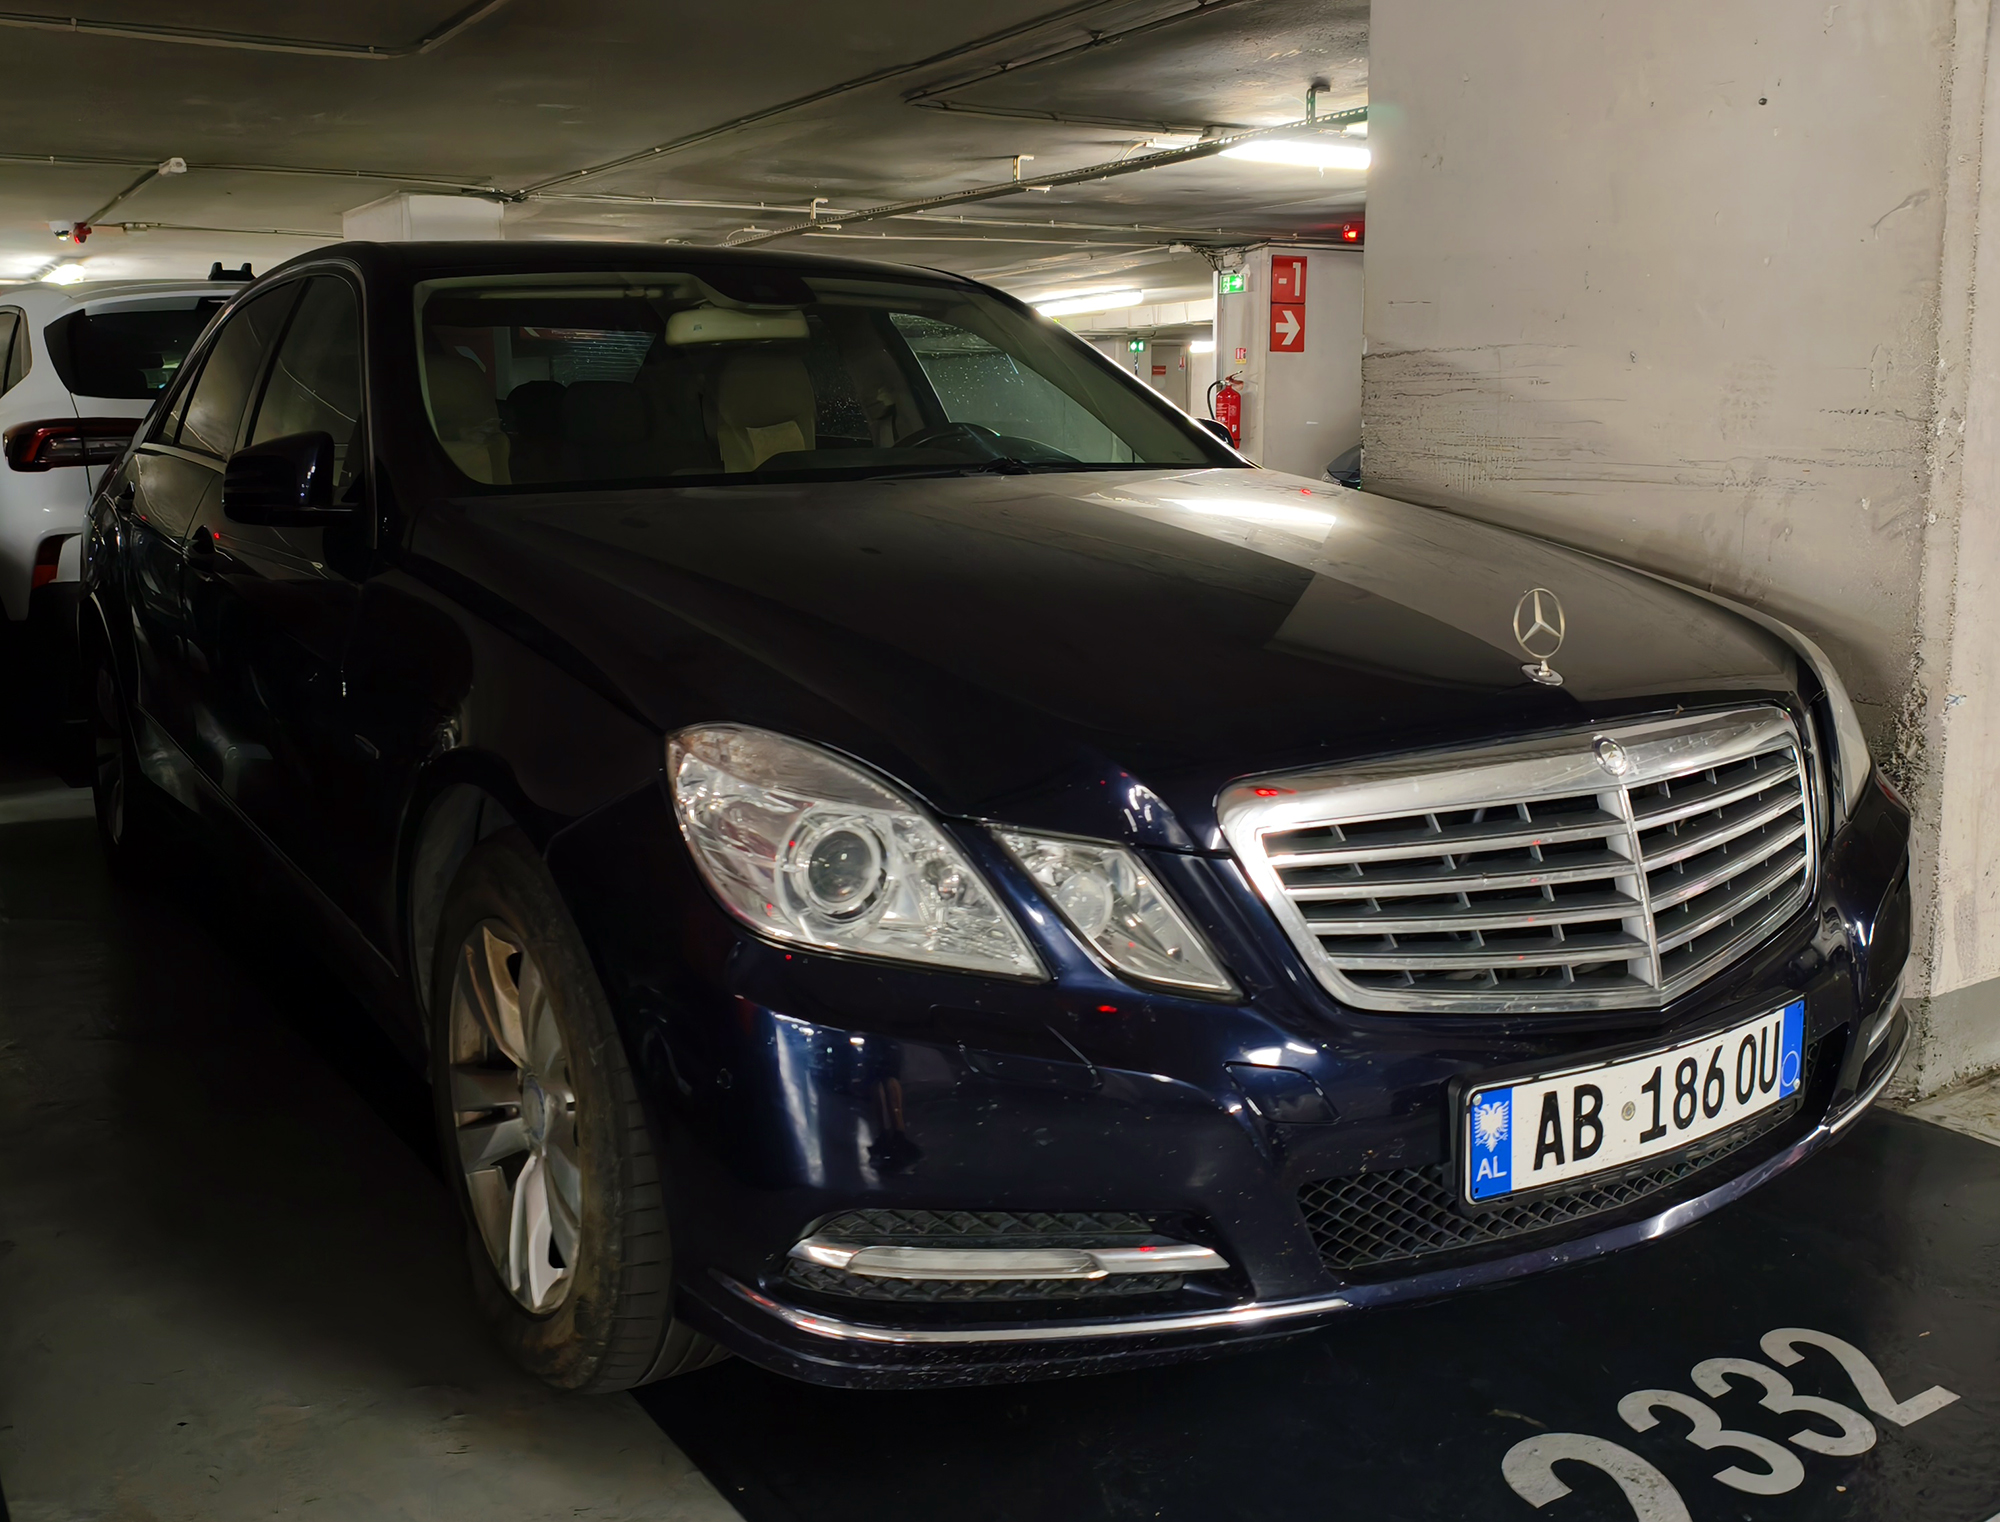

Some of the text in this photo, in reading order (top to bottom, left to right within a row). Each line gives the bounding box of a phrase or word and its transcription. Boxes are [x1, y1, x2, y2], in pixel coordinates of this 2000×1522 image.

[1533, 1084, 1604, 1171] AB
[1640, 1045, 1725, 1144] 186
[1476, 1156, 1507, 1182] AL
